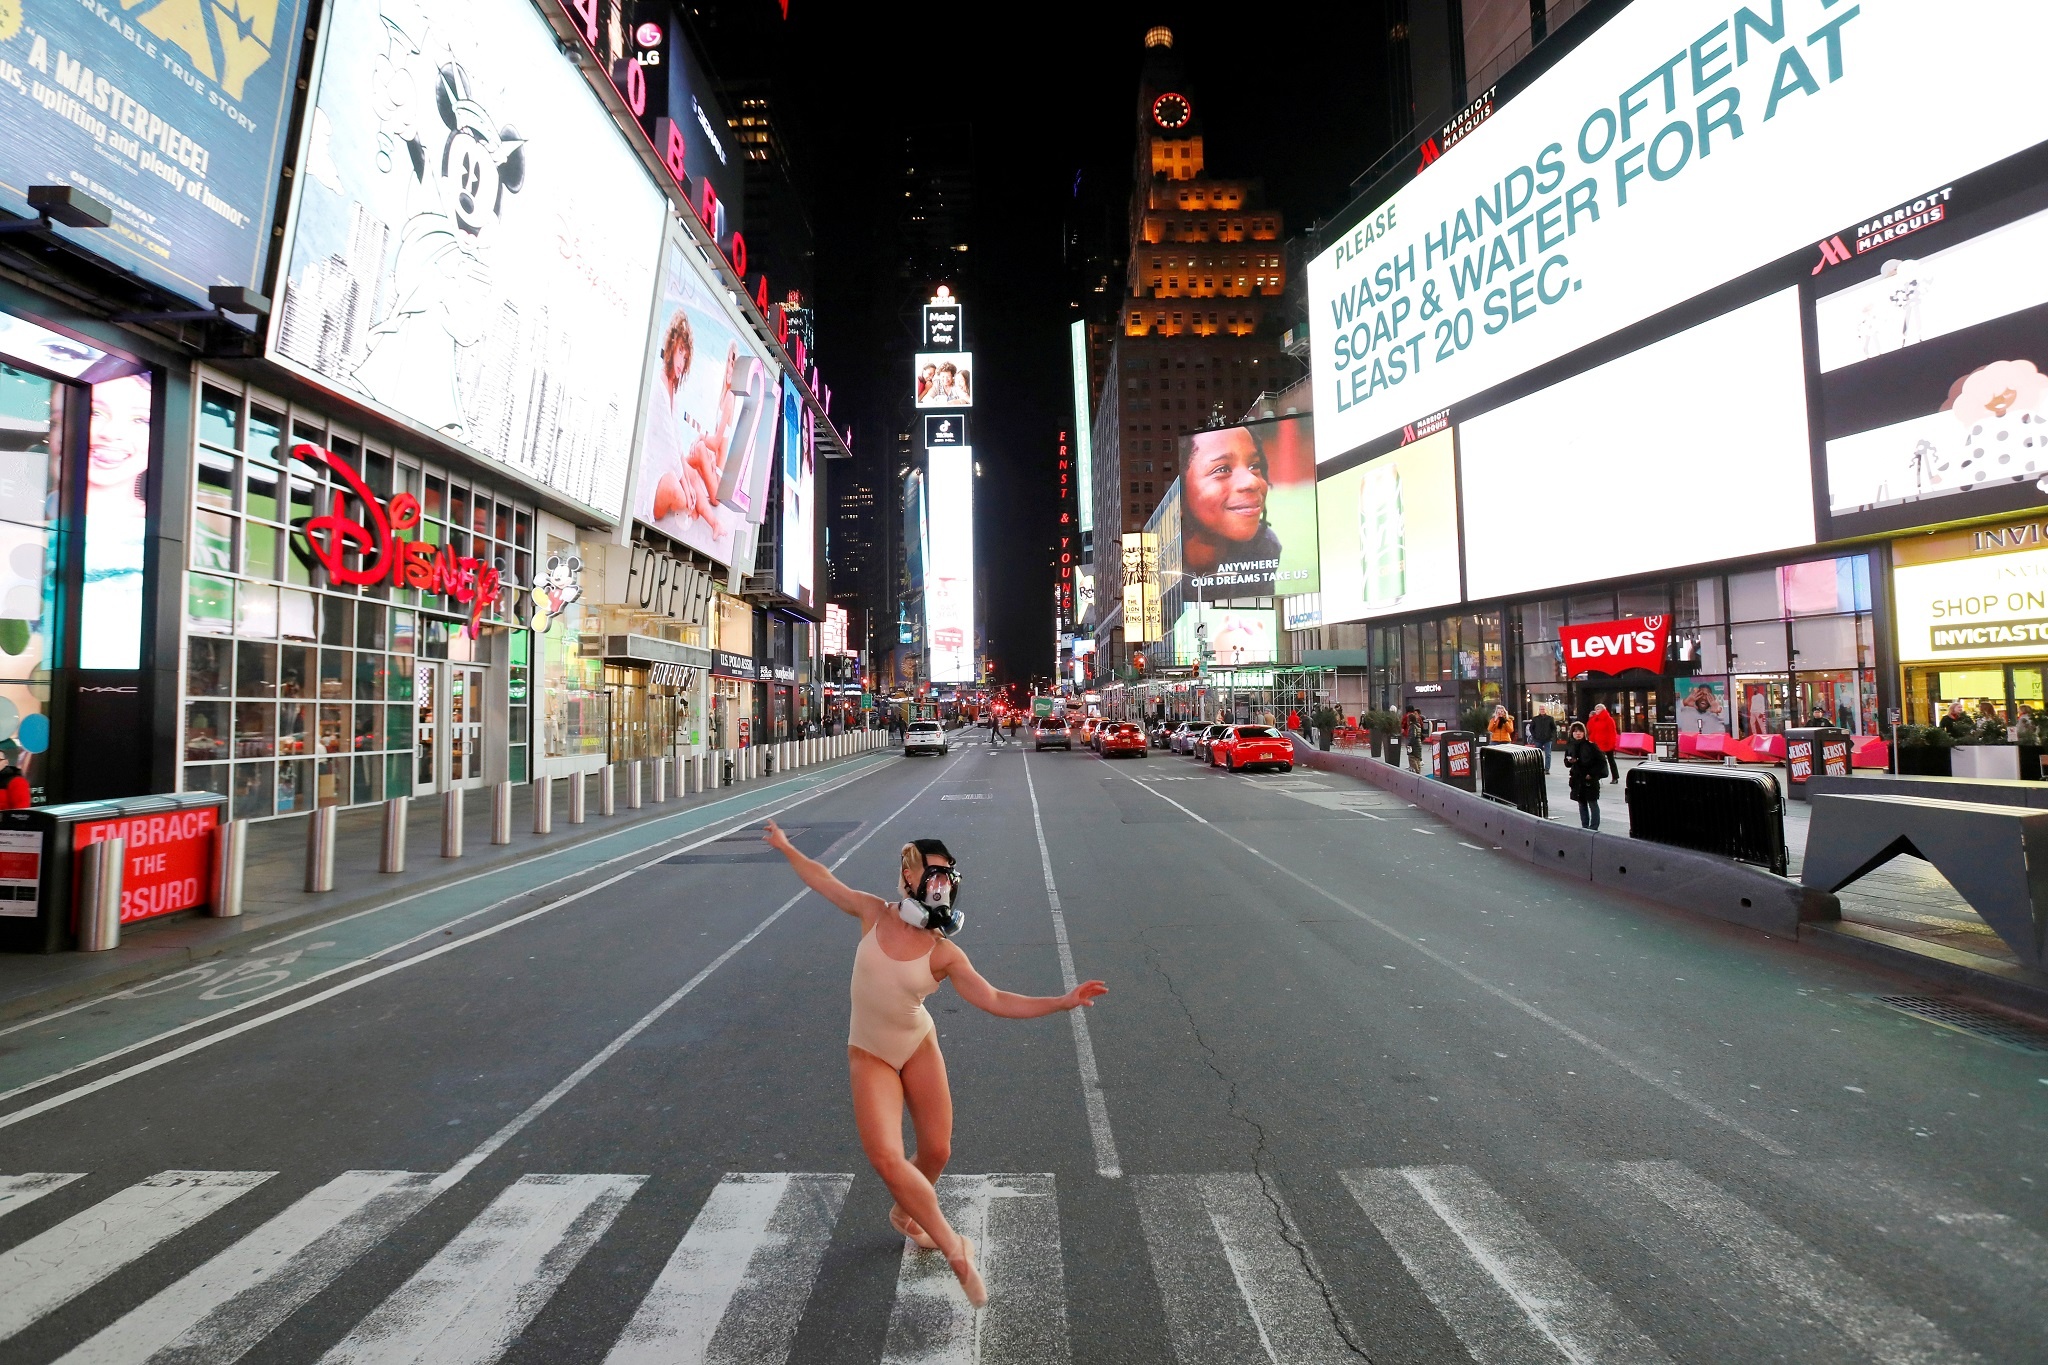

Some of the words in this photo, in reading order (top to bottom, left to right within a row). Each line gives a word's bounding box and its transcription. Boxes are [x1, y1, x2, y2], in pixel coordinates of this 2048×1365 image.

[77, 0, 158, 59] RKABLE
[162, 53, 205, 96] TRUE
[207, 90, 257, 134] STORY
[637, 50, 660, 66] LG
[55, 50, 209, 178] MASTERPIECE!
[1443, 85, 1497, 138] MARRIOTT
[0, 59, 27, 95] us,
[31, 79, 107, 142] uplifting
[109, 127, 140, 161] and
[139, 149, 186, 193] plenty
[186, 178, 203, 200] of
[1444, 104, 1491, 150] MARQUIS
[1330, 243, 1416, 330] WASH
[1424, 142, 1567, 272] HANDS
[1577, 0, 1785, 164] OFTEN
[69, 170, 88, 187] ON
[90, 180, 157, 225] BROADWAY
[1334, 295, 1411, 371] SOAP
[1420, 278, 1443, 321] &
[1449, 177, 1600, 301] WATER
[1614, 86, 1744, 208] FOR
[1763, 4, 1860, 123] AT
[1857, 187, 1953, 238] MARRIOTT
[1336, 203, 1397, 270] PLEASE
[1859, 207, 1941, 252] MARQUIS
[666, 117, 831, 415] BROADWAY
[929, 312, 956, 322] Make
[931, 322, 954, 334] your
[933, 334, 953, 344] day.
[1336, 331, 1426, 413] LEAST
[1434, 307, 1473, 363] 20
[1483, 254, 1582, 335] SEC.
[1417, 408, 1450, 429] MARRIOTT
[1417, 418, 1447, 437] MARQUIS
[1059, 431, 1068, 499] ERNST
[1061, 512, 1069, 523] &
[1061, 537, 1071, 608] YOUNG
[1217, 558, 1279, 573] ANYWHERE
[624, 539, 713, 626] FOREVER
[1191, 574, 1214, 588] OUR
[1216, 573, 1260, 586] DREAMS
[1262, 571, 1291, 582] TAKE
[1293, 569, 1308, 580] US
[1932, 595, 1998, 618] SHOP
[651, 662, 687, 687] FOREVER
[728, 656, 741, 669] POLO
[1447, 741, 1470, 757] JERSEY
[1789, 742, 1812, 759] JERSEY
[1823, 742, 1847, 760] JERSEY
[1450, 758, 1470, 772] BOYS
[1791, 761, 1811, 777] BOYS
[1826, 762, 1846, 777] BOYS
[90, 811, 211, 850] EMBRACE
[132, 852, 167, 877] THE
[121, 877, 199, 921] BSURD
